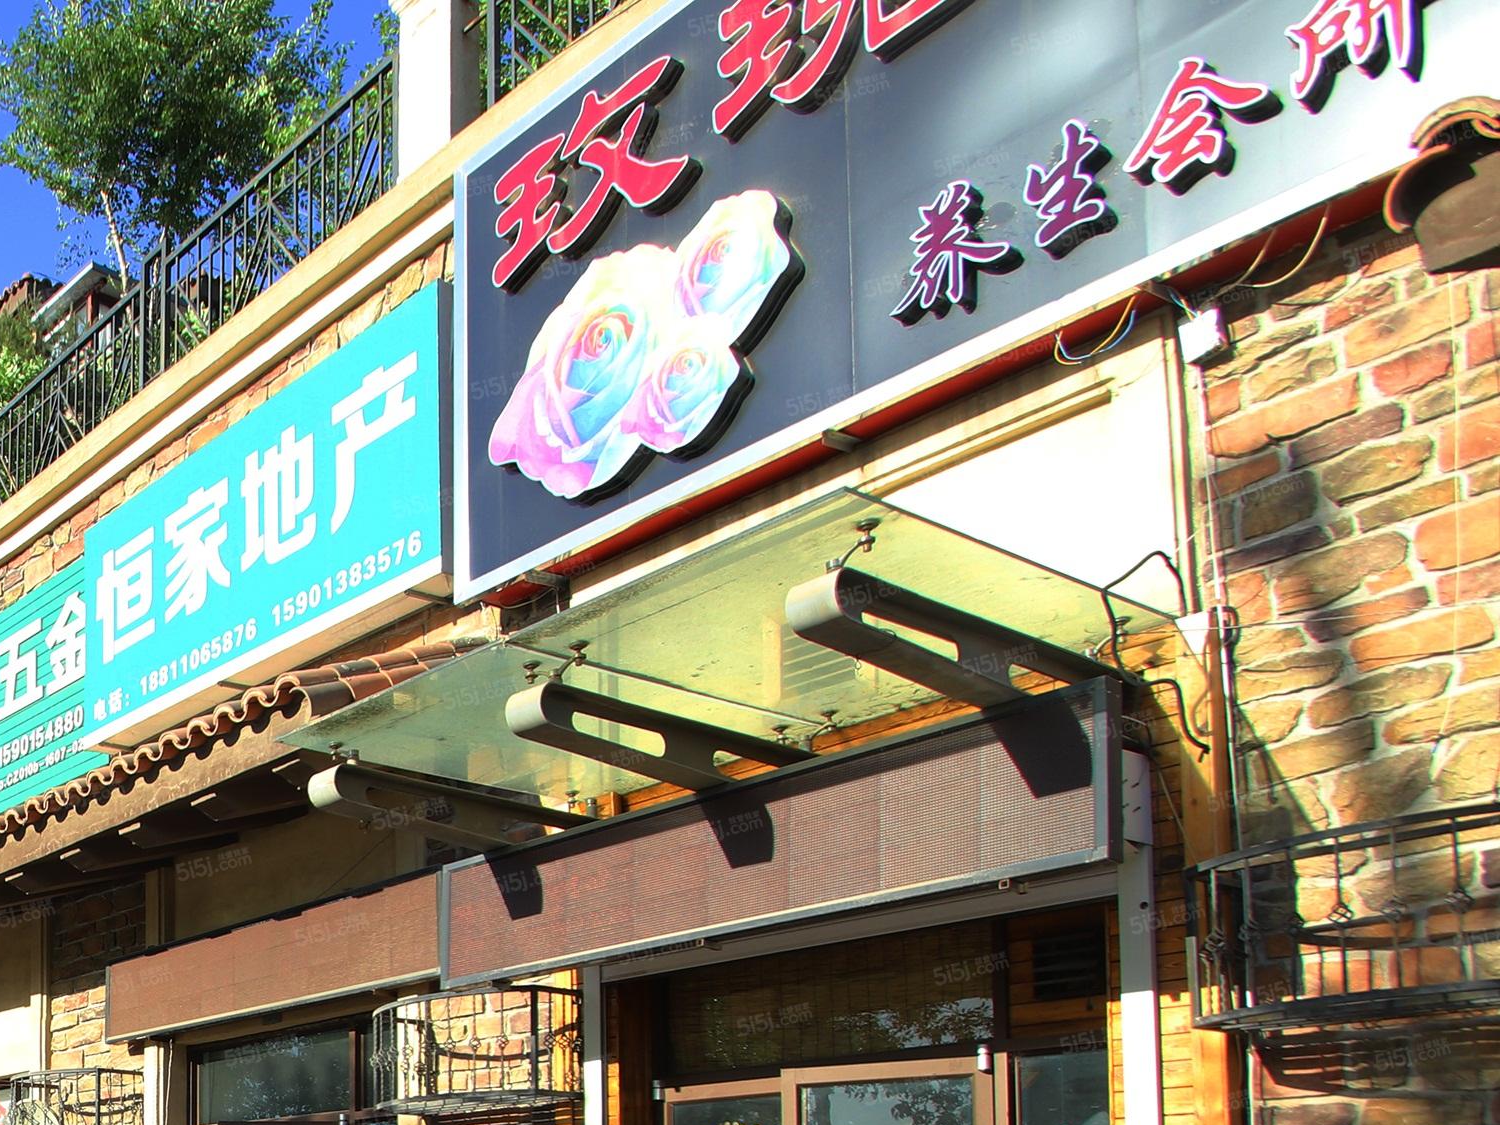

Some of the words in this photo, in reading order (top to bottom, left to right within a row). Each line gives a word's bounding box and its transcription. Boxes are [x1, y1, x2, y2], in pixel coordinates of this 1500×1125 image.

[892, 0, 1422, 324] 养生会所
[95, 350, 418, 662] 恒家地产
[139, 618, 258, 698] 18811065876
[271, 530, 423, 627] 15901383576
